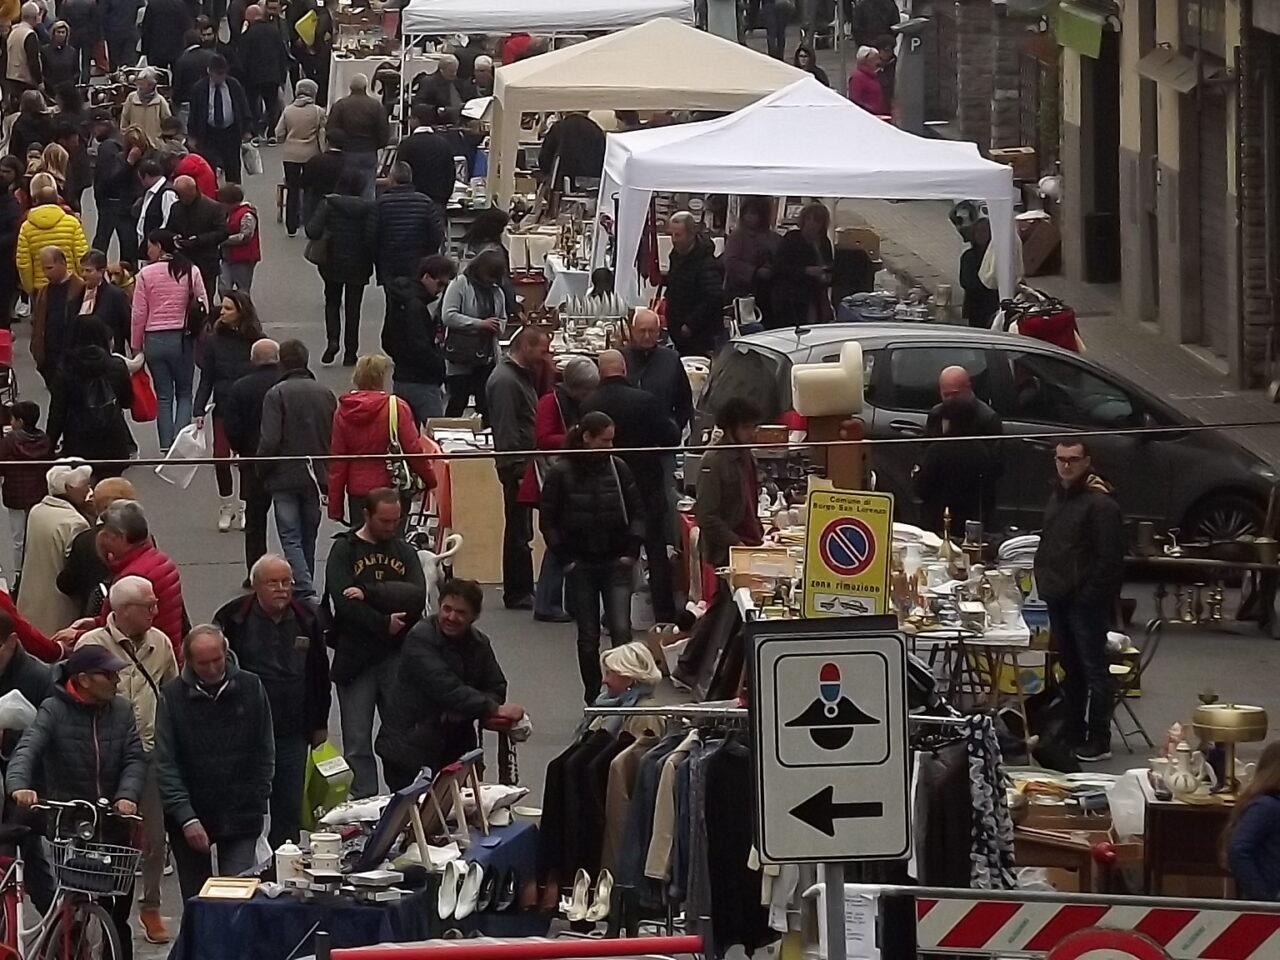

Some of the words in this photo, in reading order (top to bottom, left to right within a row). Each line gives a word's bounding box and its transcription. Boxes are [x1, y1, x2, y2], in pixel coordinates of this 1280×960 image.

[911, 37, 921, 51] P
[829, 496, 862, 505] Comune
[813, 502, 836, 511] Borgo
[838, 504, 854, 512] San
[856, 506, 888, 515] Lorenzo
[811, 580, 831, 589] zona
[835, 581, 881, 593] rimozione
